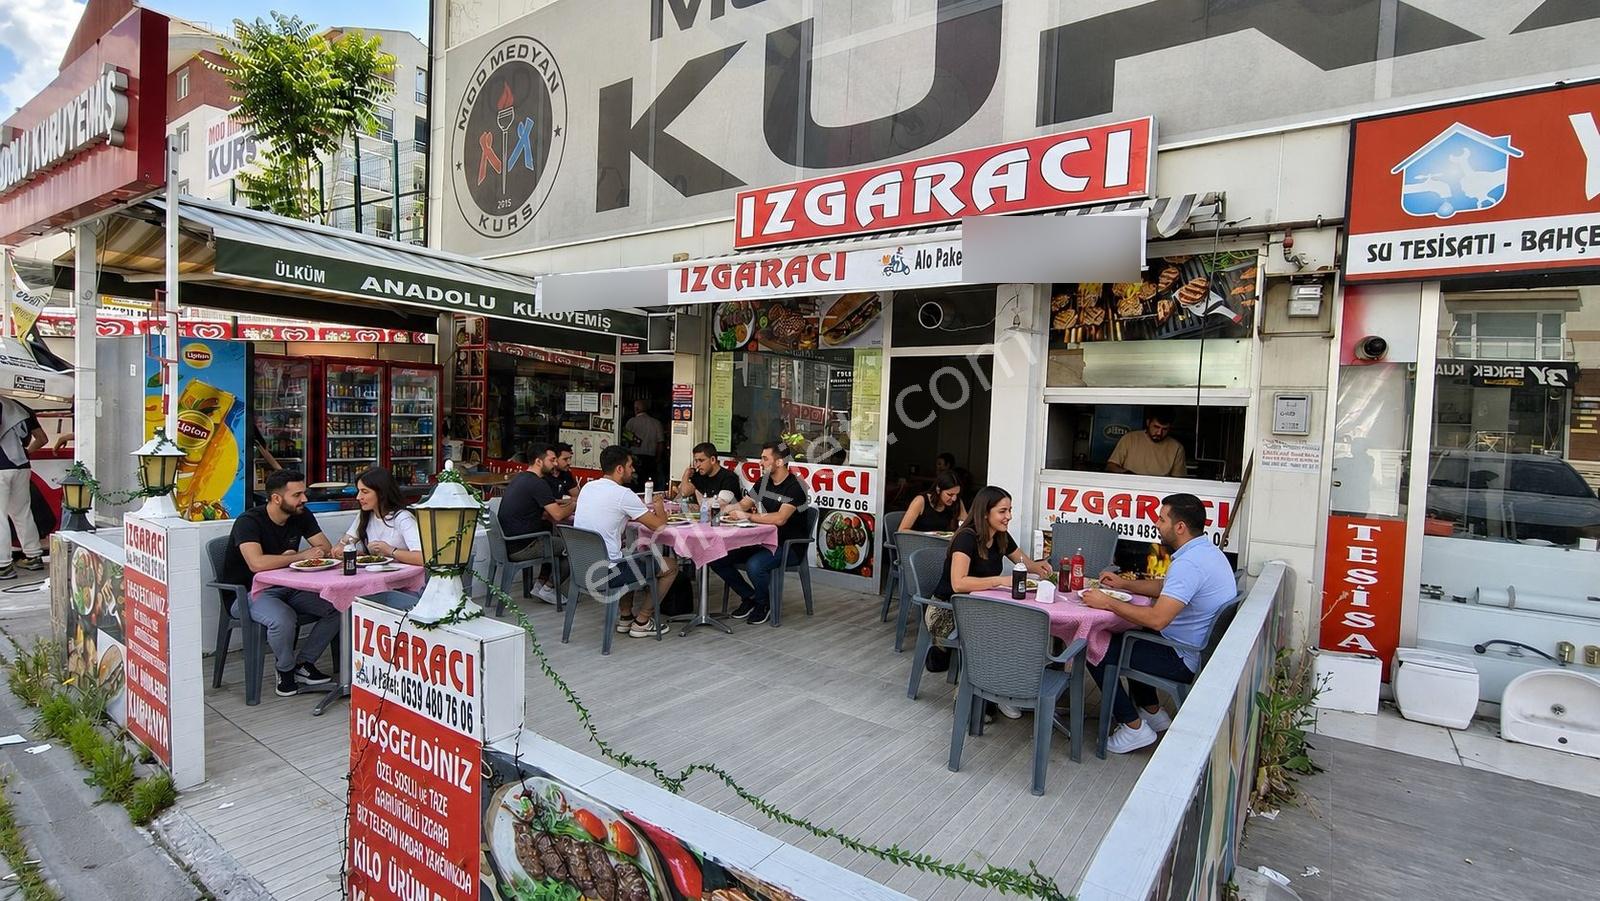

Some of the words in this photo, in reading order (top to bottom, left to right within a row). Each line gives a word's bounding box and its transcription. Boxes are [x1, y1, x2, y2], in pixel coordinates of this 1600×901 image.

[458, 69, 487, 130] MOD
[490, 44, 560, 95] MEDYAN
[208, 134, 257, 180] KURS
[740, 129, 1133, 239] IZGARACI
[478, 203, 533, 233] KURS
[1366, 242, 1392, 263] SU
[1399, 232, 1496, 261] TESİSATI
[1520, 224, 1600, 254] BAHÇE
[274, 259, 326, 285] ÜLKÜM
[360, 275, 497, 310] ANADOLU
[679, 251, 847, 293] IZGARACI
[914, 249, 932, 271] Alo
[837, 498, 851, 509] 76
[854, 500, 869, 511] 06
[1047, 487, 1230, 529] IZGARI
[354, 614, 474, 698] IZGARACI
[401, 675, 423, 711] 0539
[425, 686, 443, 721] 480
[445, 694, 458, 727] 76
[460, 700, 474, 734] 06
[356, 707, 473, 794] HOŞGELDİNİZ
[376, 755, 393, 786] ÖZEL
[394, 769, 417, 800] SOSLU
[428, 788, 449, 818] TAZE
[354, 836, 382, 883] KİLO
